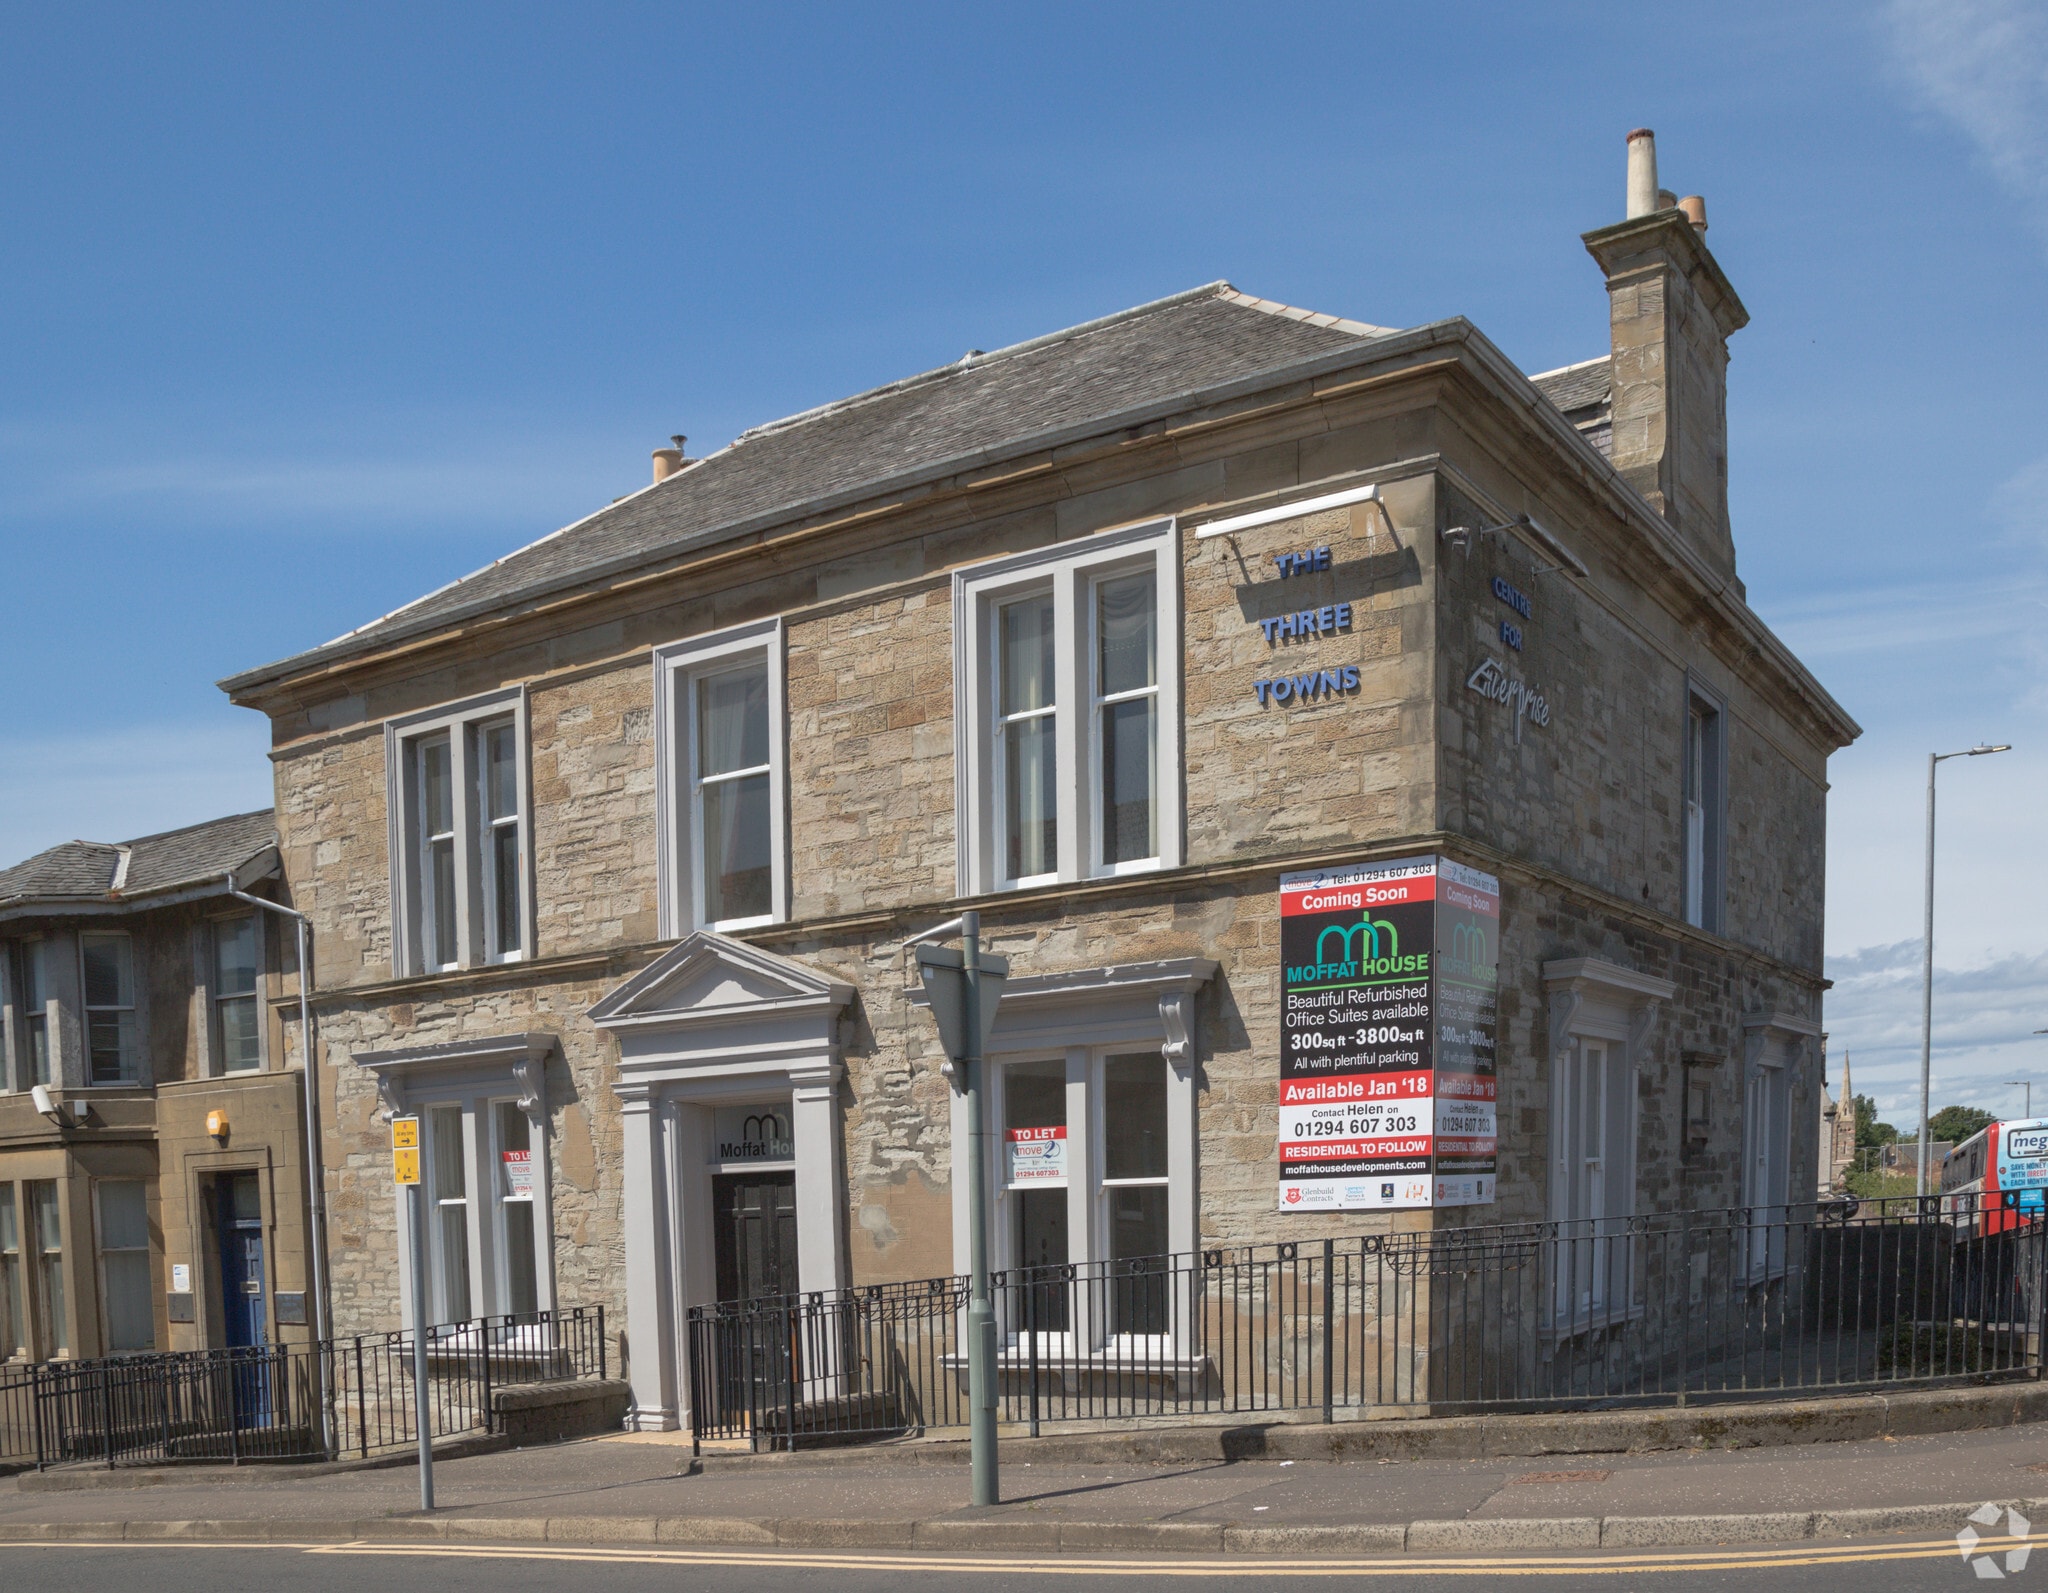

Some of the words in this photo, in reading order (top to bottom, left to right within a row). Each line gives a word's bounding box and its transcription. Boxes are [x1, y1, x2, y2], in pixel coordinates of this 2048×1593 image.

[1274, 546, 1330, 579] THE
[1491, 576, 1532, 619] CENTRE
[1260, 602, 1351, 641] THREE
[1501, 620, 1522, 650] FOR
[1253, 665, 1359, 703] TOWNS
[1332, 873, 1351, 885] Tel:
[1353, 867, 1386, 883] 01294
[1390, 866, 1408, 879] 607
[1412, 863, 1432, 875] 303
[1302, 891, 1361, 910] Coming
[1366, 886, 1408, 903] Soon
[1447, 886, 1472, 909] Coming
[1473, 894, 1490, 911] Soon
[1287, 960, 1358, 983] MOFFAT
[1362, 953, 1429, 976] HOUSE
[1472, 963, 1497, 983] HOUSE
[1287, 991, 1344, 1010] Beautiful
[1347, 983, 1428, 1005] Refurbished
[1286, 1012, 1325, 1027] Office
[1328, 1008, 1369, 1025] Suites
[1372, 1002, 1429, 1020] available
[1337, 1035, 1346, 1047] ft
[1415, 1029, 1424, 1041] ft
[1294, 1057, 1307, 1070] All
[1310, 1055, 1331, 1068] with
[1334, 1052, 1376, 1070] plentiful
[1379, 1050, 1419, 1067] parking
[1285, 1081, 1363, 1101] Available
[1368, 1080, 1397, 1095] Jan
[1439, 1078, 1472, 1096] Available
[1472, 1081, 1484, 1096] Jan
[1312, 1108, 1345, 1118] Contact
[1347, 1104, 1383, 1116] Helen
[1464, 1103, 1479, 1114] Helen
[1295, 1120, 1345, 1137] 01294
[1350, 1118, 1380, 1134] 607
[1385, 1116, 1417, 1132] 303
[1442, 1116, 1463, 1132] 01294
[1464, 1117, 1477, 1132] 607
[1478, 1118, 1491, 1133] 303
[1015, 1129, 1032, 1140] TO
[1035, 1128, 1056, 1139] LET
[2014, 1135, 2048, 1150] meg
[509, 1152, 520, 1161] TO
[721, 1142, 766, 1158] Moffat
[1285, 1143, 1359, 1158] RESIDENTIAL
[1361, 1142, 1376, 1154] TO
[1378, 1140, 1427, 1153] FOLLOW
[512, 1165, 530, 1174] move
[1285, 1160, 1426, 1175] moffathousedevelopments.com
[2010, 1163, 2025, 1171] SAVE
[2026, 1162, 2047, 1170] MONEY
[2010, 1171, 2026, 1179] WITH
[2027, 1169, 2047, 1177] DIRECT
[1302, 1187, 1335, 1196] Glenbuild
[2010, 1179, 2026, 1187] EACH
[1302, 1194, 1334, 1203] Contracts
